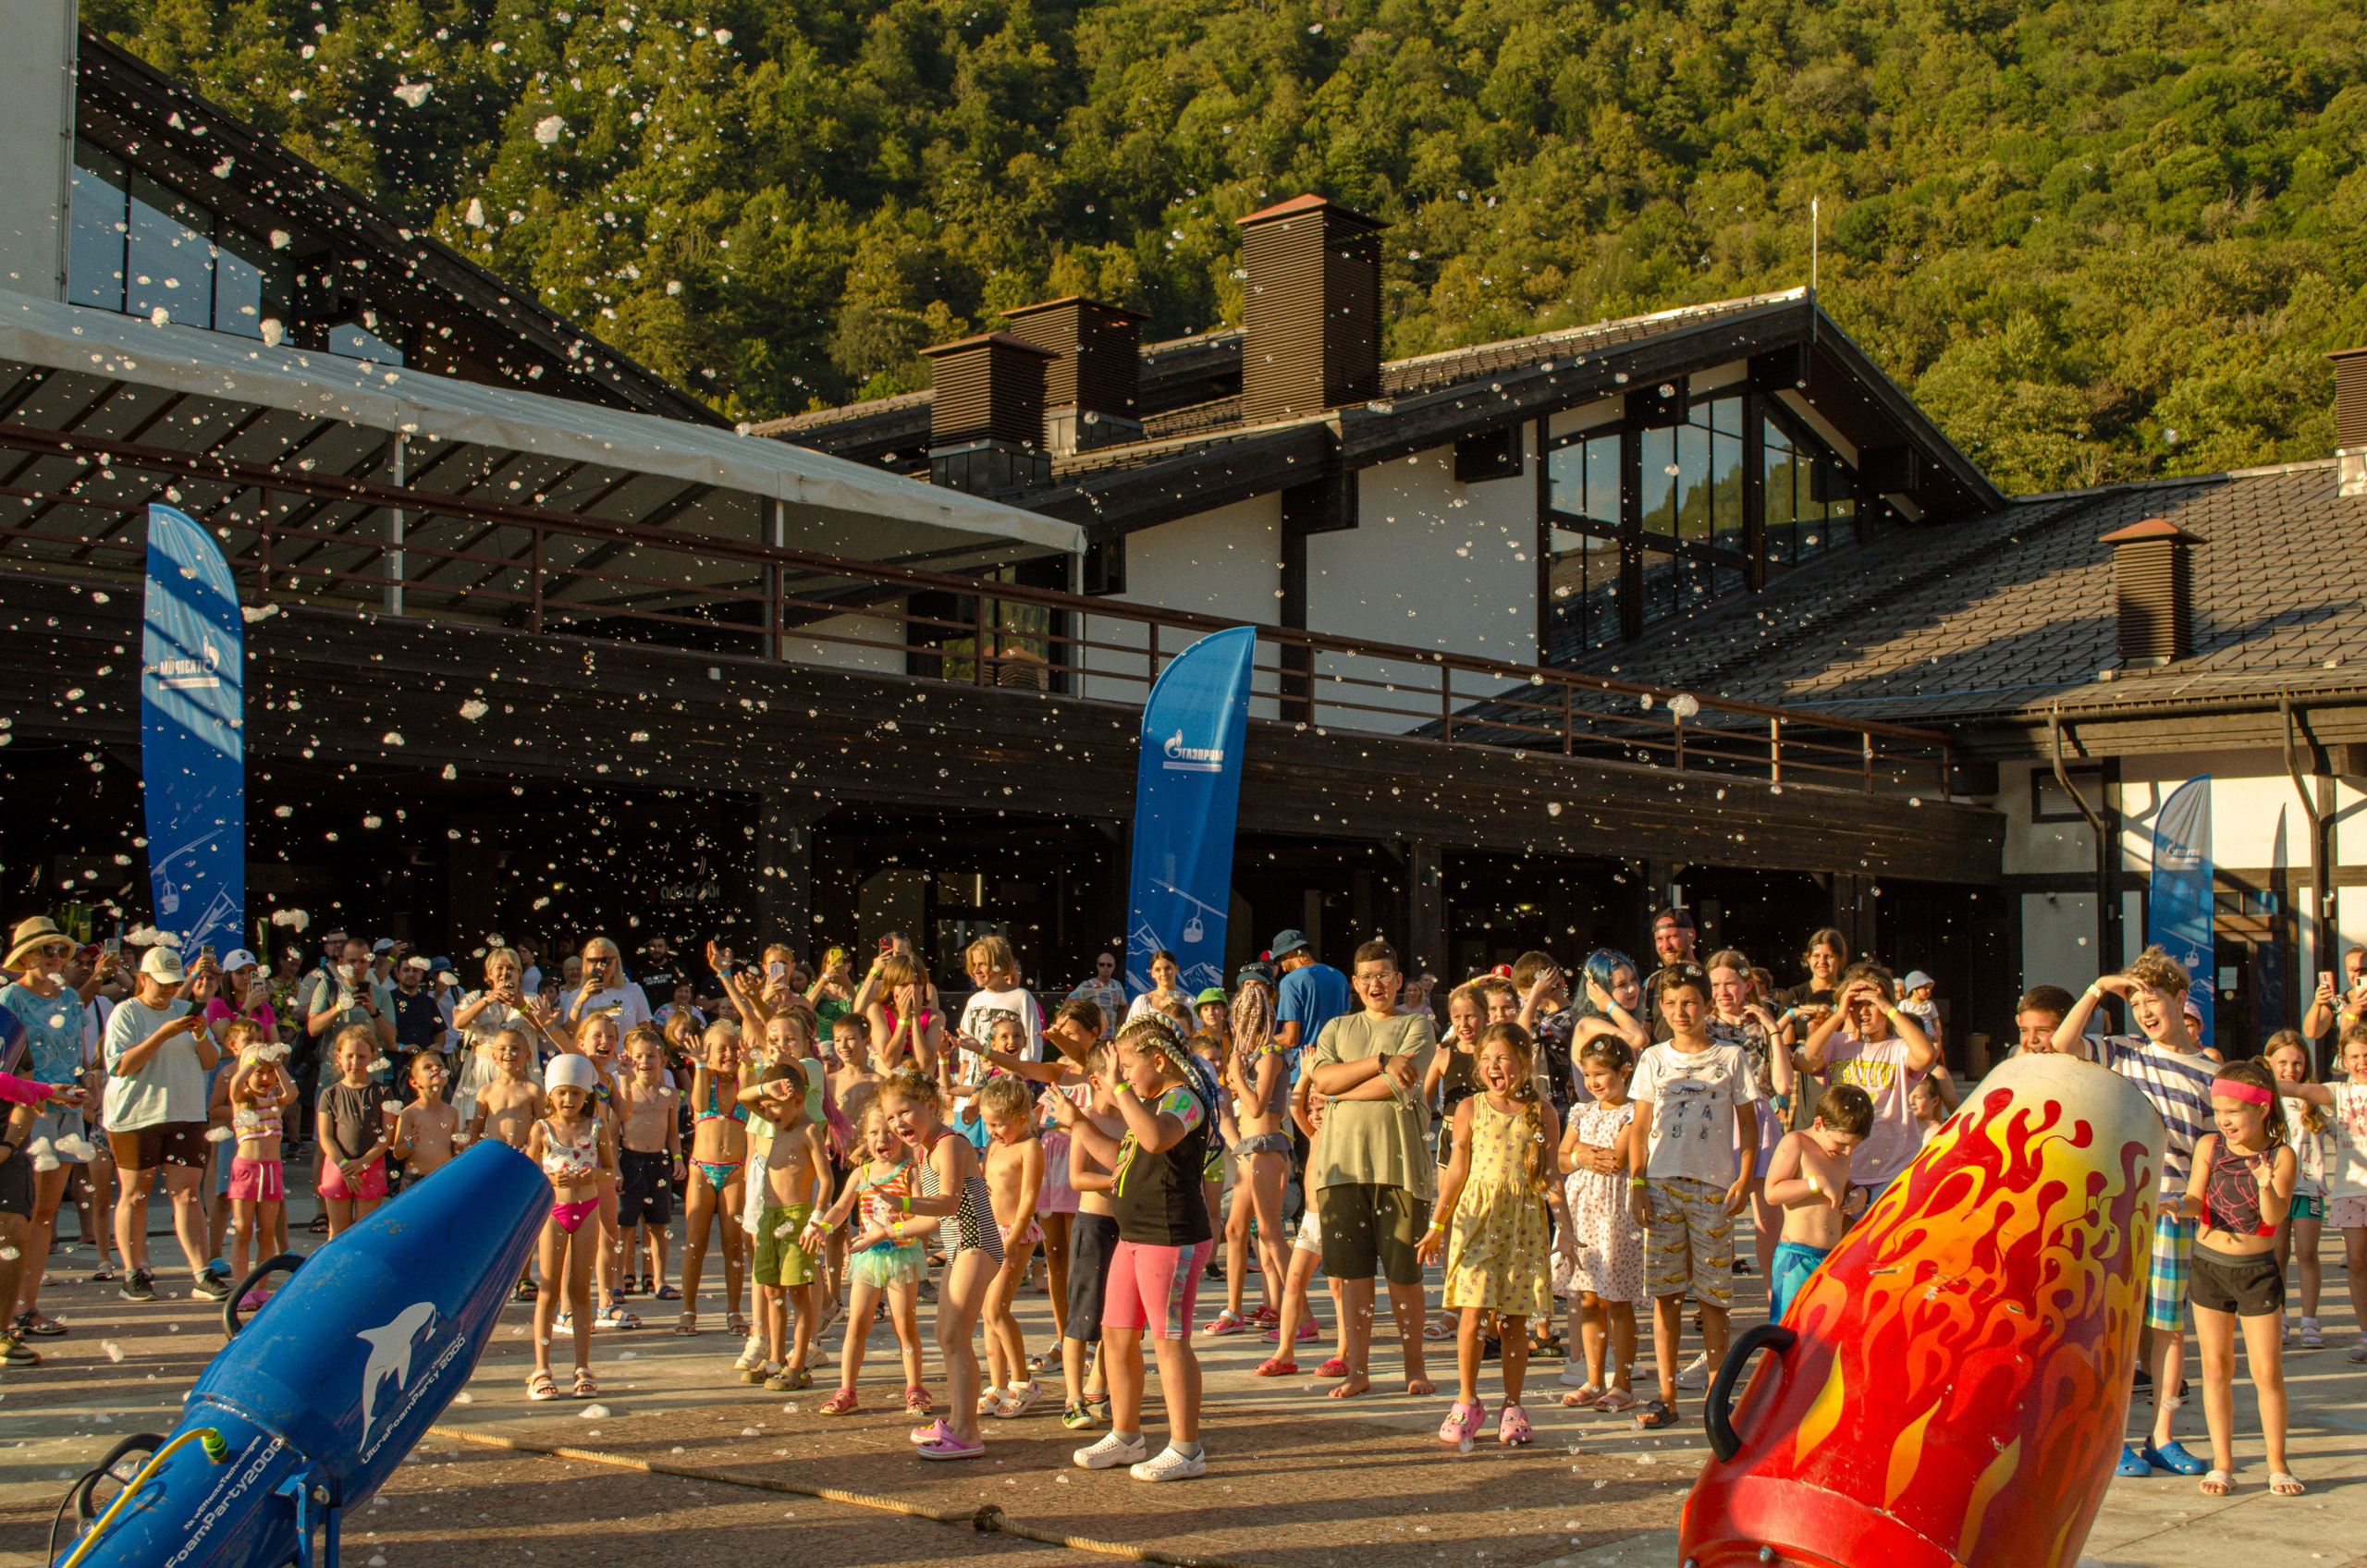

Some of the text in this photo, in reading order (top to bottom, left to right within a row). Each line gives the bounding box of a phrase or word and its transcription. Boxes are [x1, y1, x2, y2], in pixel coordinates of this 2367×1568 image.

[1182, 747, 1224, 762] ГАЗПРОМ
[361, 1336, 466, 1464] UltraFoamParty 2000
